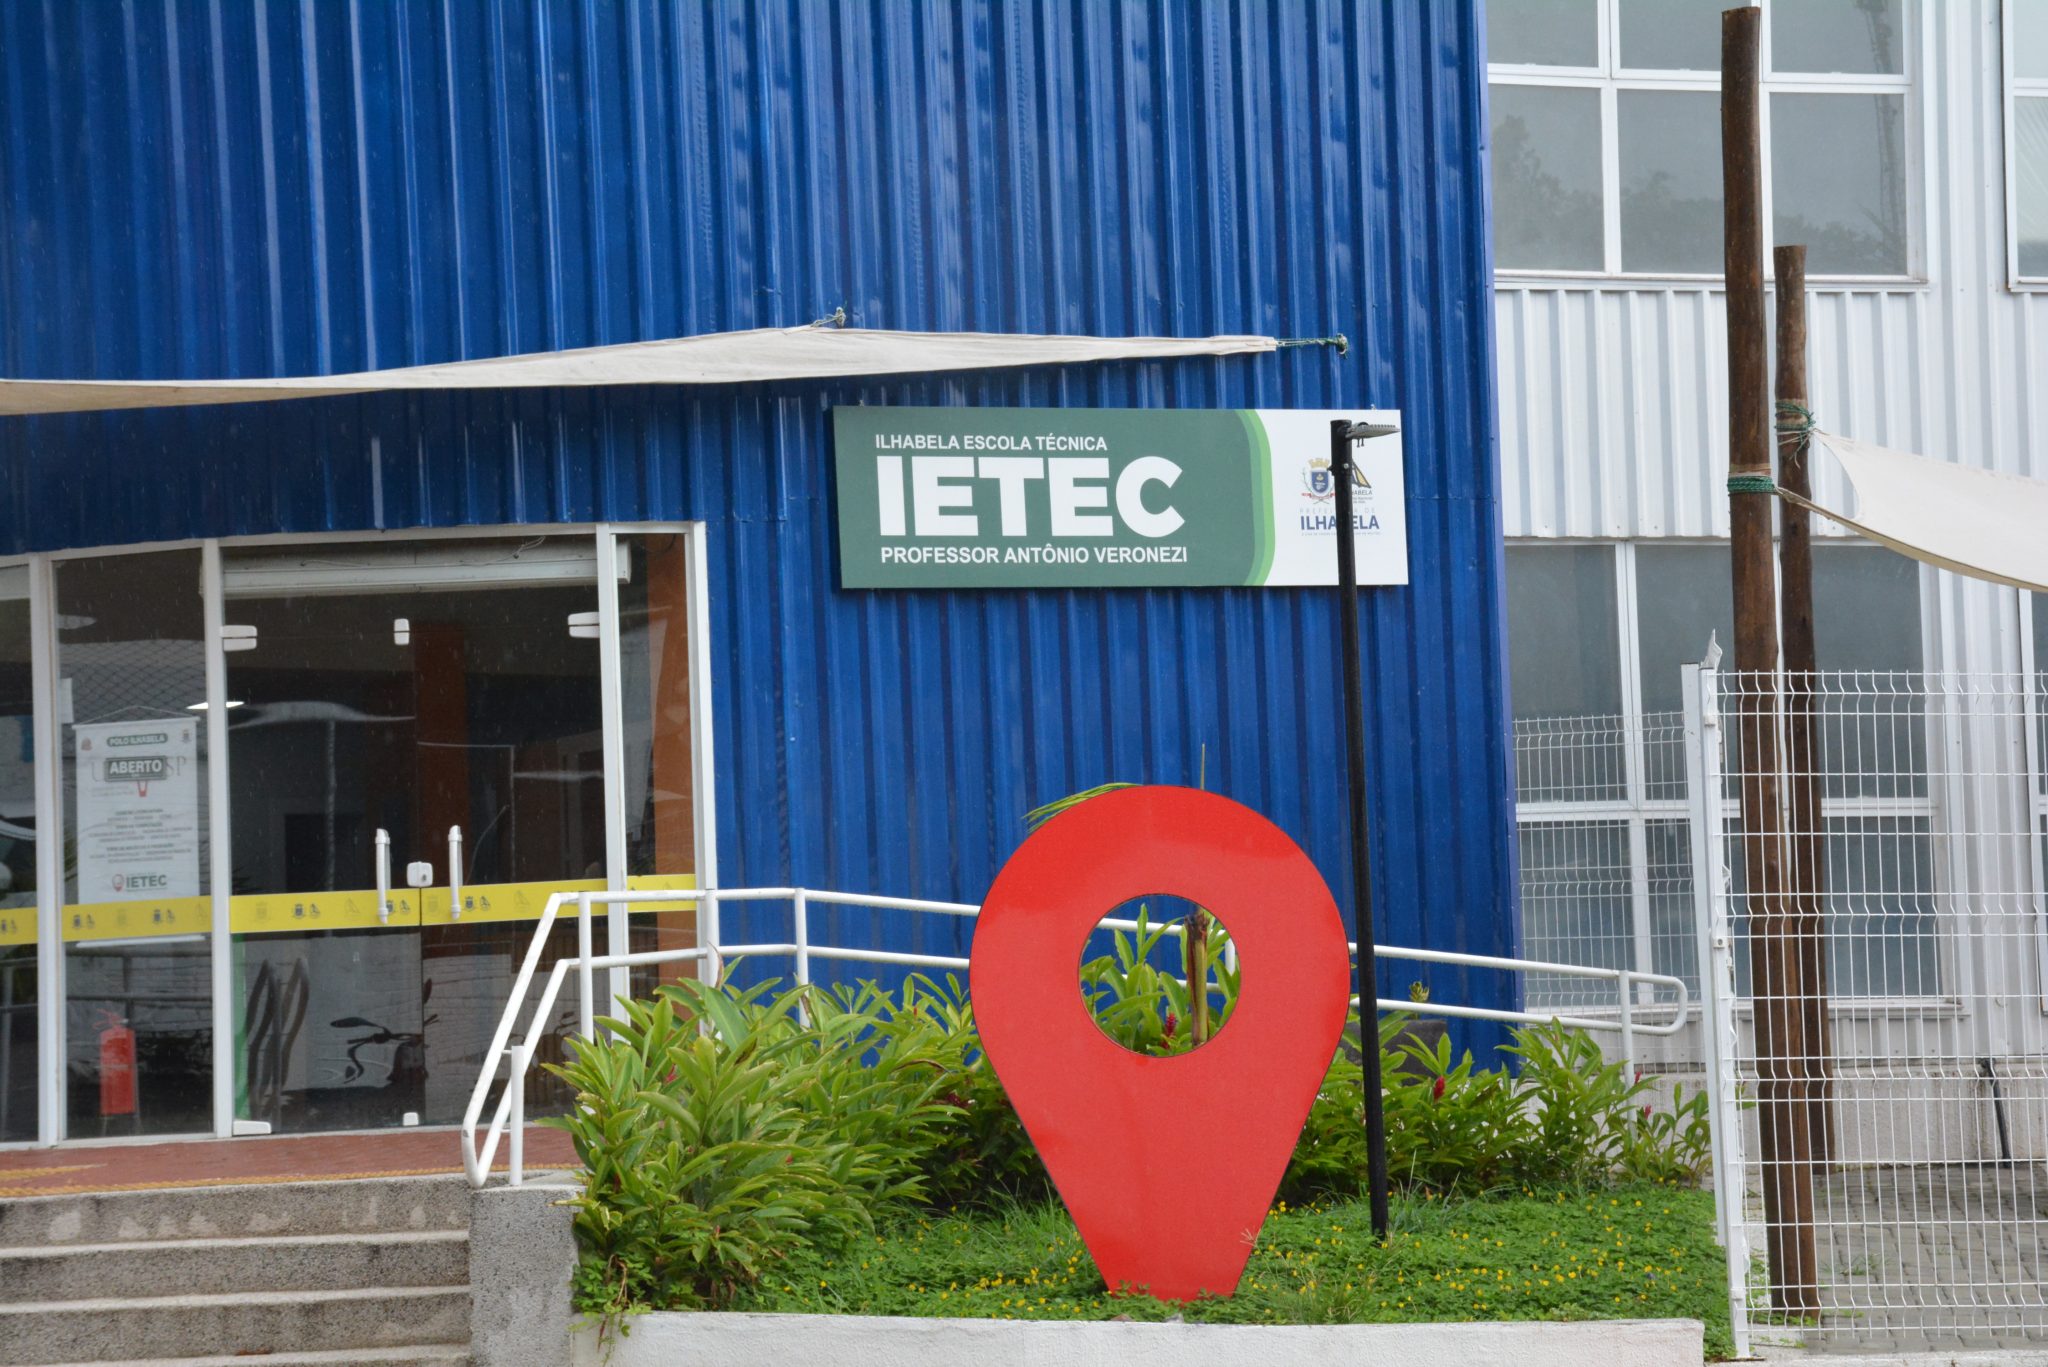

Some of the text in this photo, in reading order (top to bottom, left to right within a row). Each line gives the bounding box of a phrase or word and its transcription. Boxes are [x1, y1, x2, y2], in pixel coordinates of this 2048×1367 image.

[875, 432, 1107, 451] ILHABELA ESCOLA TÉCNICA
[877, 455, 1186, 538] IETEC
[1300, 515, 1380, 530] ILHAELA
[881, 543, 1187, 564] PROFESSOR ANTÔNIO VERONEZI
[109, 736, 129, 746] POLO
[109, 759, 162, 775] ABERTO
[126, 875, 167, 889] IETEC
